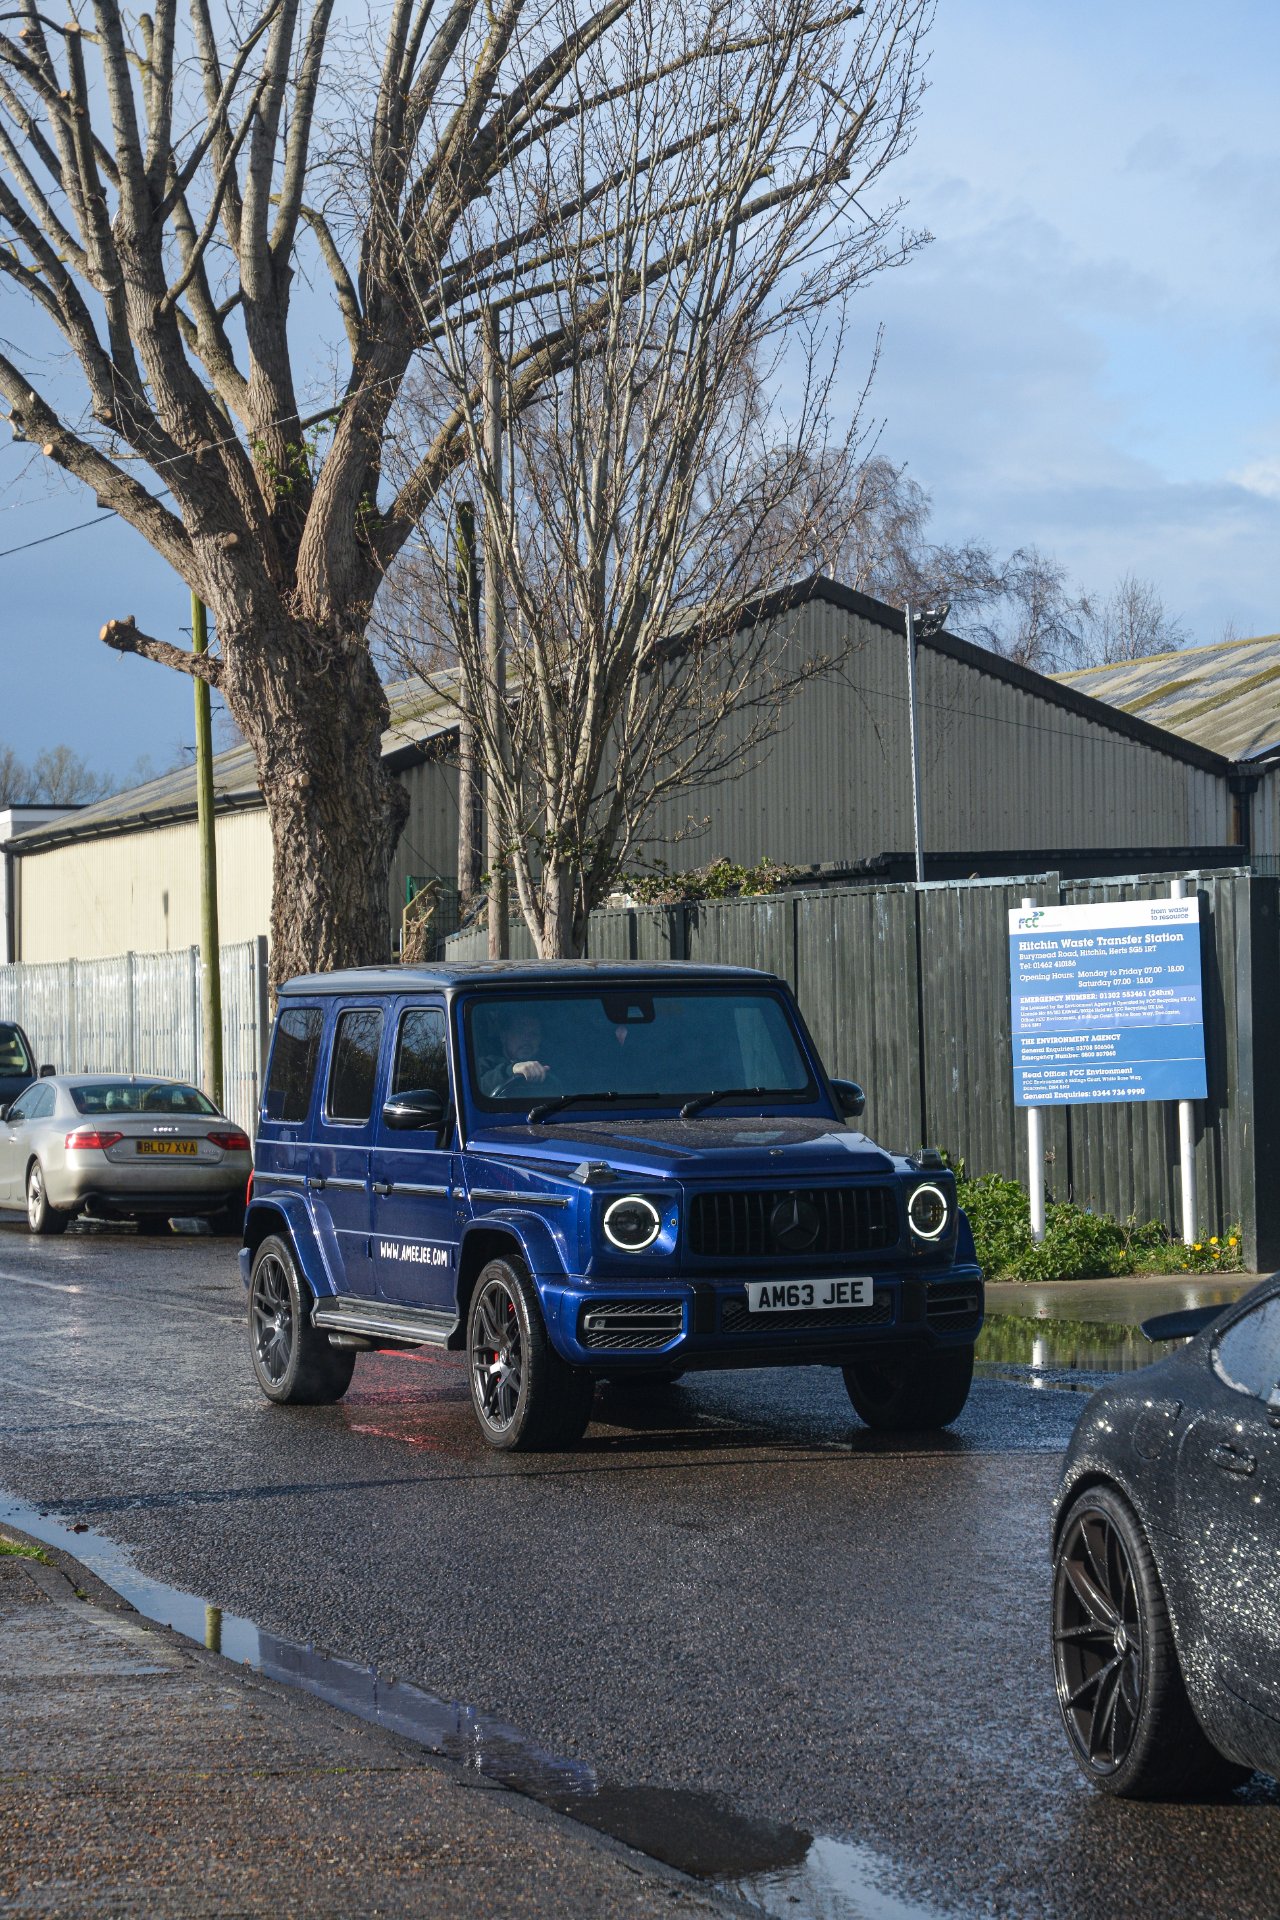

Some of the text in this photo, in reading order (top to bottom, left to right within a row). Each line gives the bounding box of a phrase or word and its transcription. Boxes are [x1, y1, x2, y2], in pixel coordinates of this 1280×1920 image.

[1018, 917, 1040, 929] FCC
[1019, 932, 1184, 951] Hitchin Waste Transfer Station
[1019, 951, 1057, 961] Burymead
[1058, 950, 1079, 958] Road,
[1080, 948, 1108, 957] Hitchin,
[1109, 947, 1128, 955] Herts
[1033, 961, 1053, 969] 01462
[1020, 973, 1051, 983] Opening
[1052, 971, 1075, 979] Hours:
[1078, 970, 1108, 979] Monday
[1118, 967, 1143, 977] Friday
[1144, 966, 1163, 974] 07.00
[1167, 965, 1185, 973] 18.00
[1078, 979, 1112, 989] Saturday
[1020, 995, 1064, 1004] EMERGENCY
[1066, 993, 1098, 1001] NUMBER:
[1149, 989, 1174, 997] (24hrs)
[1036, 1035, 1089, 1044] ENVIRONMENT
[1022, 1054, 1054, 1062] Emergency
[1086, 1067, 1133, 1075] Environment
[1023, 1092, 1053, 1100] General
[1054, 1091, 1091, 1099] Enquiries:
[143, 1141, 171, 1153] BL07
[175, 1142, 196, 1153] XVA
[380, 1241, 448, 1268] WWW.AMEEJEE.COM
[758, 1282, 864, 1309] AM63 JEE
